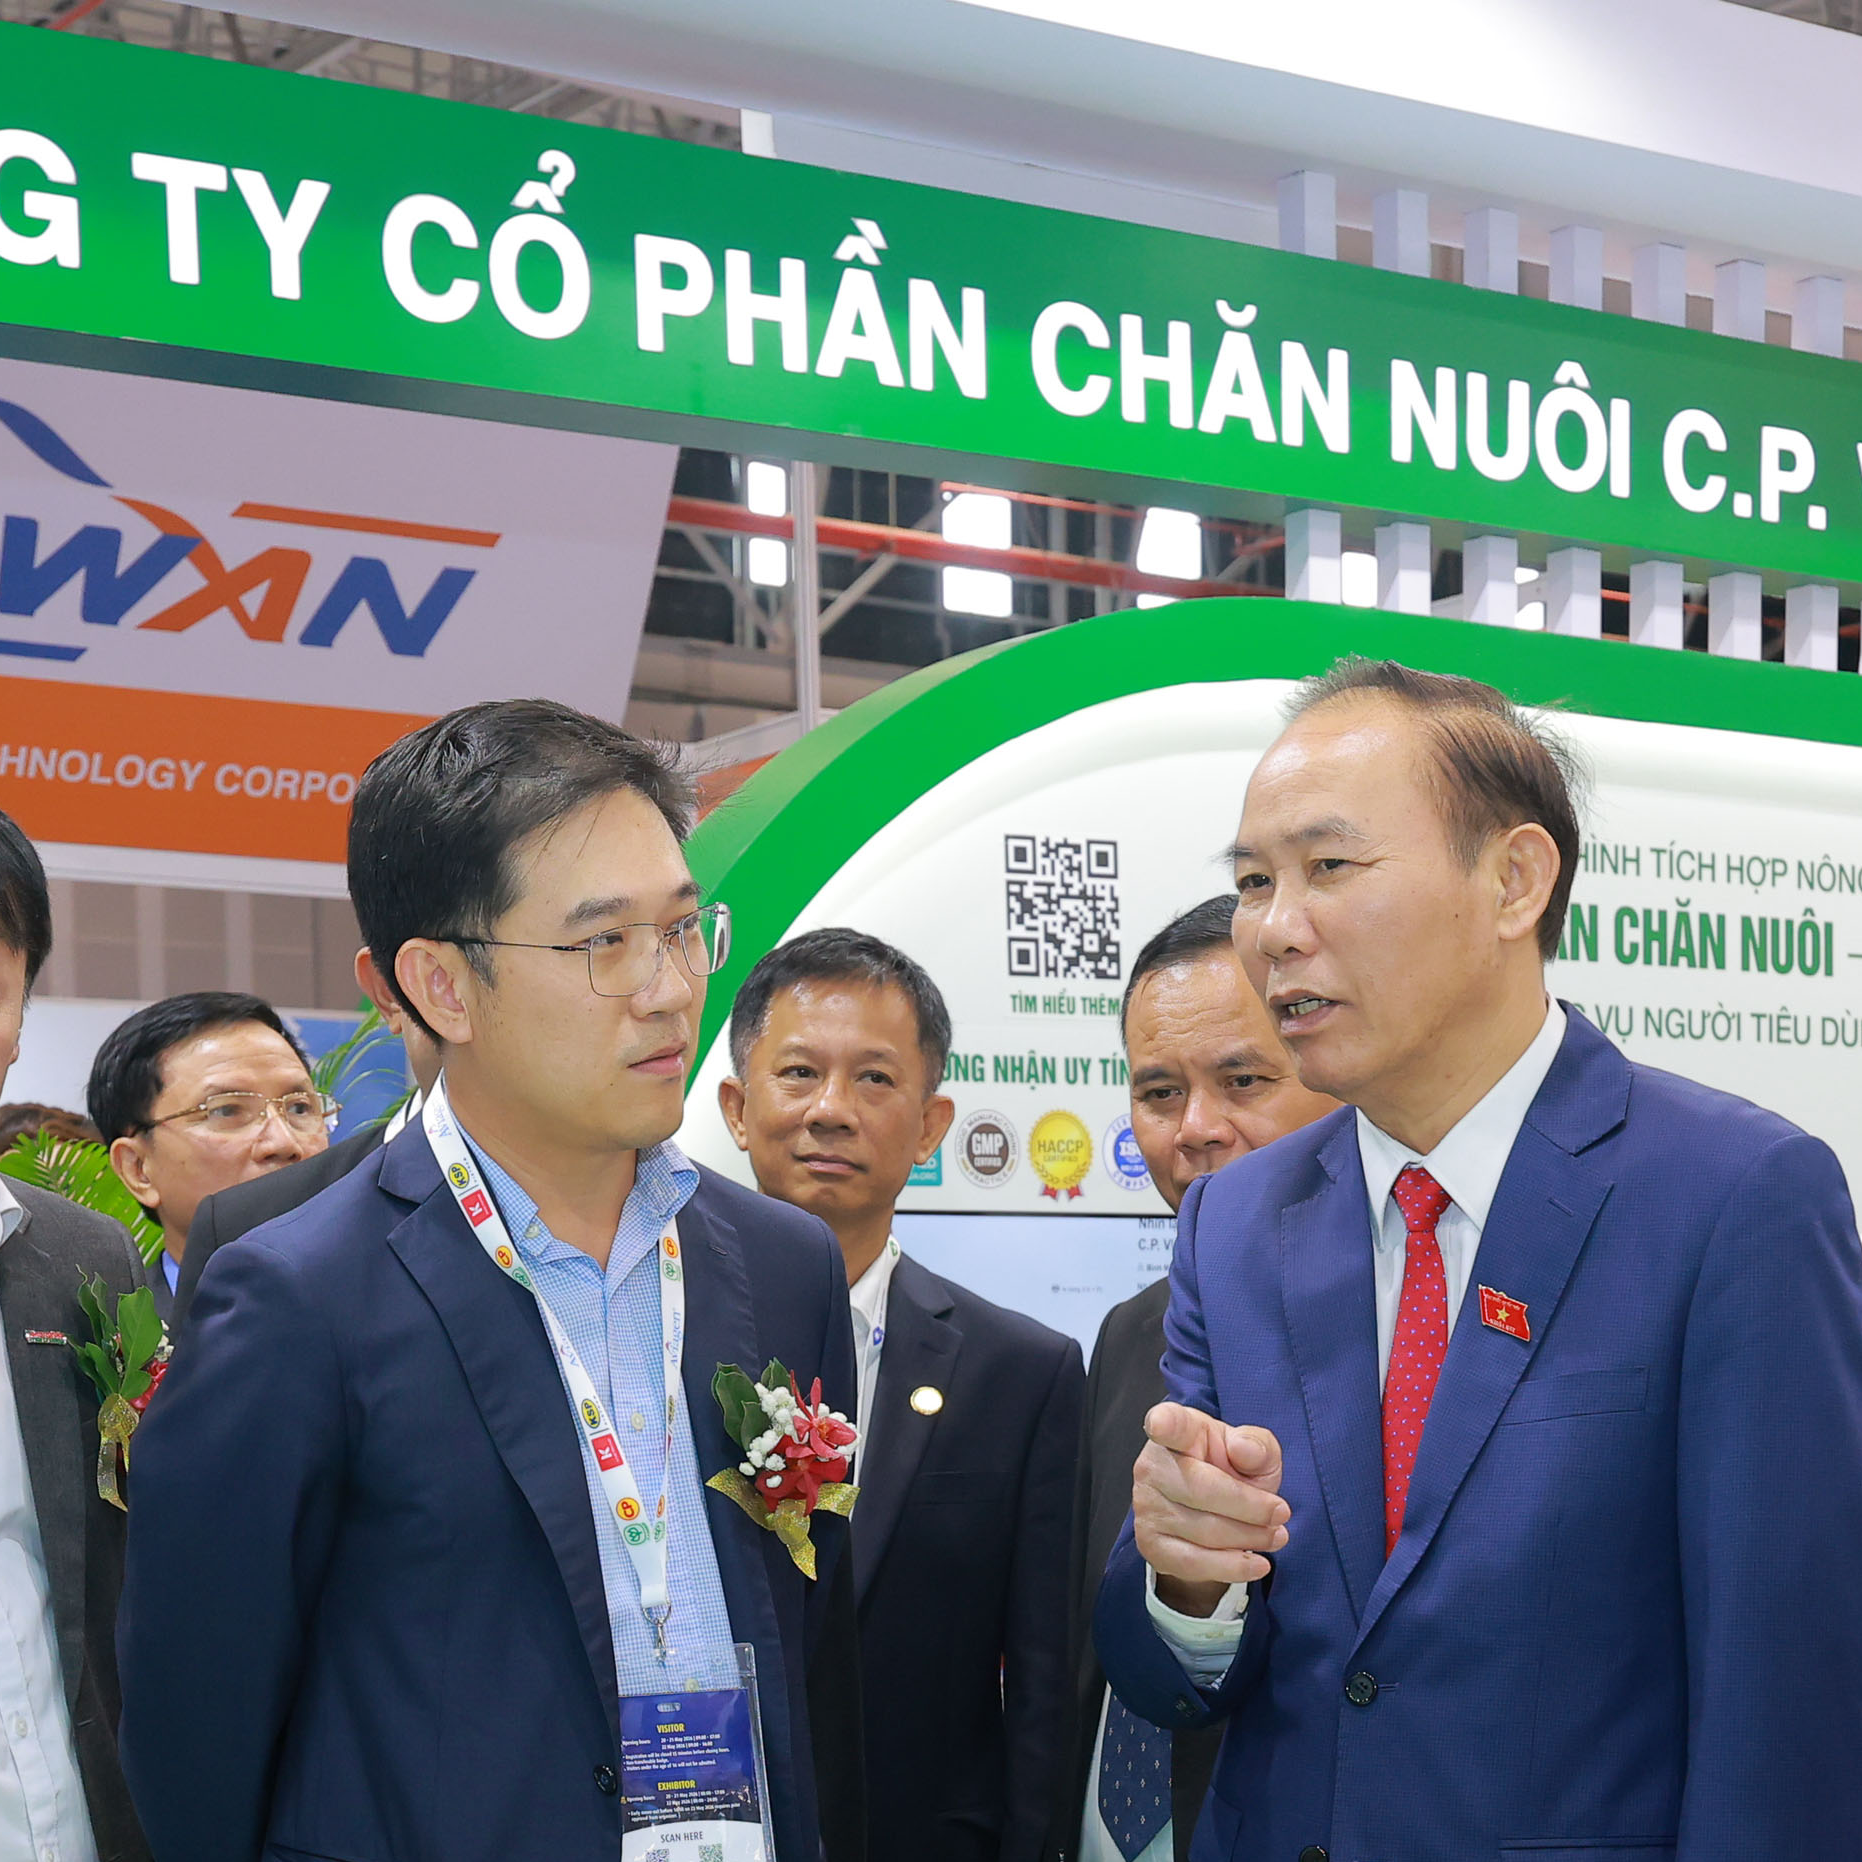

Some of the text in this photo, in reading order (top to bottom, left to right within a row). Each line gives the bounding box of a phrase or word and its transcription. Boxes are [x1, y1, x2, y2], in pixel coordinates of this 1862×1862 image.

[131, 150, 331, 300] TY
[382, 148, 592, 340] CỔ
[633, 217, 986, 398] PHẦN
[1030, 300, 1349, 454] CHĂN
[1389, 358, 1632, 499] NUÔI
[1662, 410, 1828, 531] C.P.
[1650, 840, 1715, 882] TÍCH
[1727, 854, 1788, 894] HỢP
[1614, 897, 1726, 970] CHĂN
[1741, 907, 1833, 976] NUÔI
[1010, 988, 1120, 1015] TÌM HIỂU THÊM
[1595, 1003, 1634, 1043] VỤ
[1644, 1001, 1740, 1042] NGƯỜI
[1750, 1006, 1810, 1045] TIÊU
[994, 1050, 1056, 1090] NHẬN
[1065, 1058, 1091, 1084] UY
[972, 1133, 1004, 1155] GMP
[1038, 1140, 1083, 1154] HACCP
[452, 1166, 467, 1186] KSP
[583, 1402, 600, 1427] KSP
[620, 1501, 637, 1517] CP
[657, 1723, 685, 1734] VISITOR
[658, 1780, 696, 1791] EXHIBITOR
[660, 1831, 704, 1844] SCAN HERE
